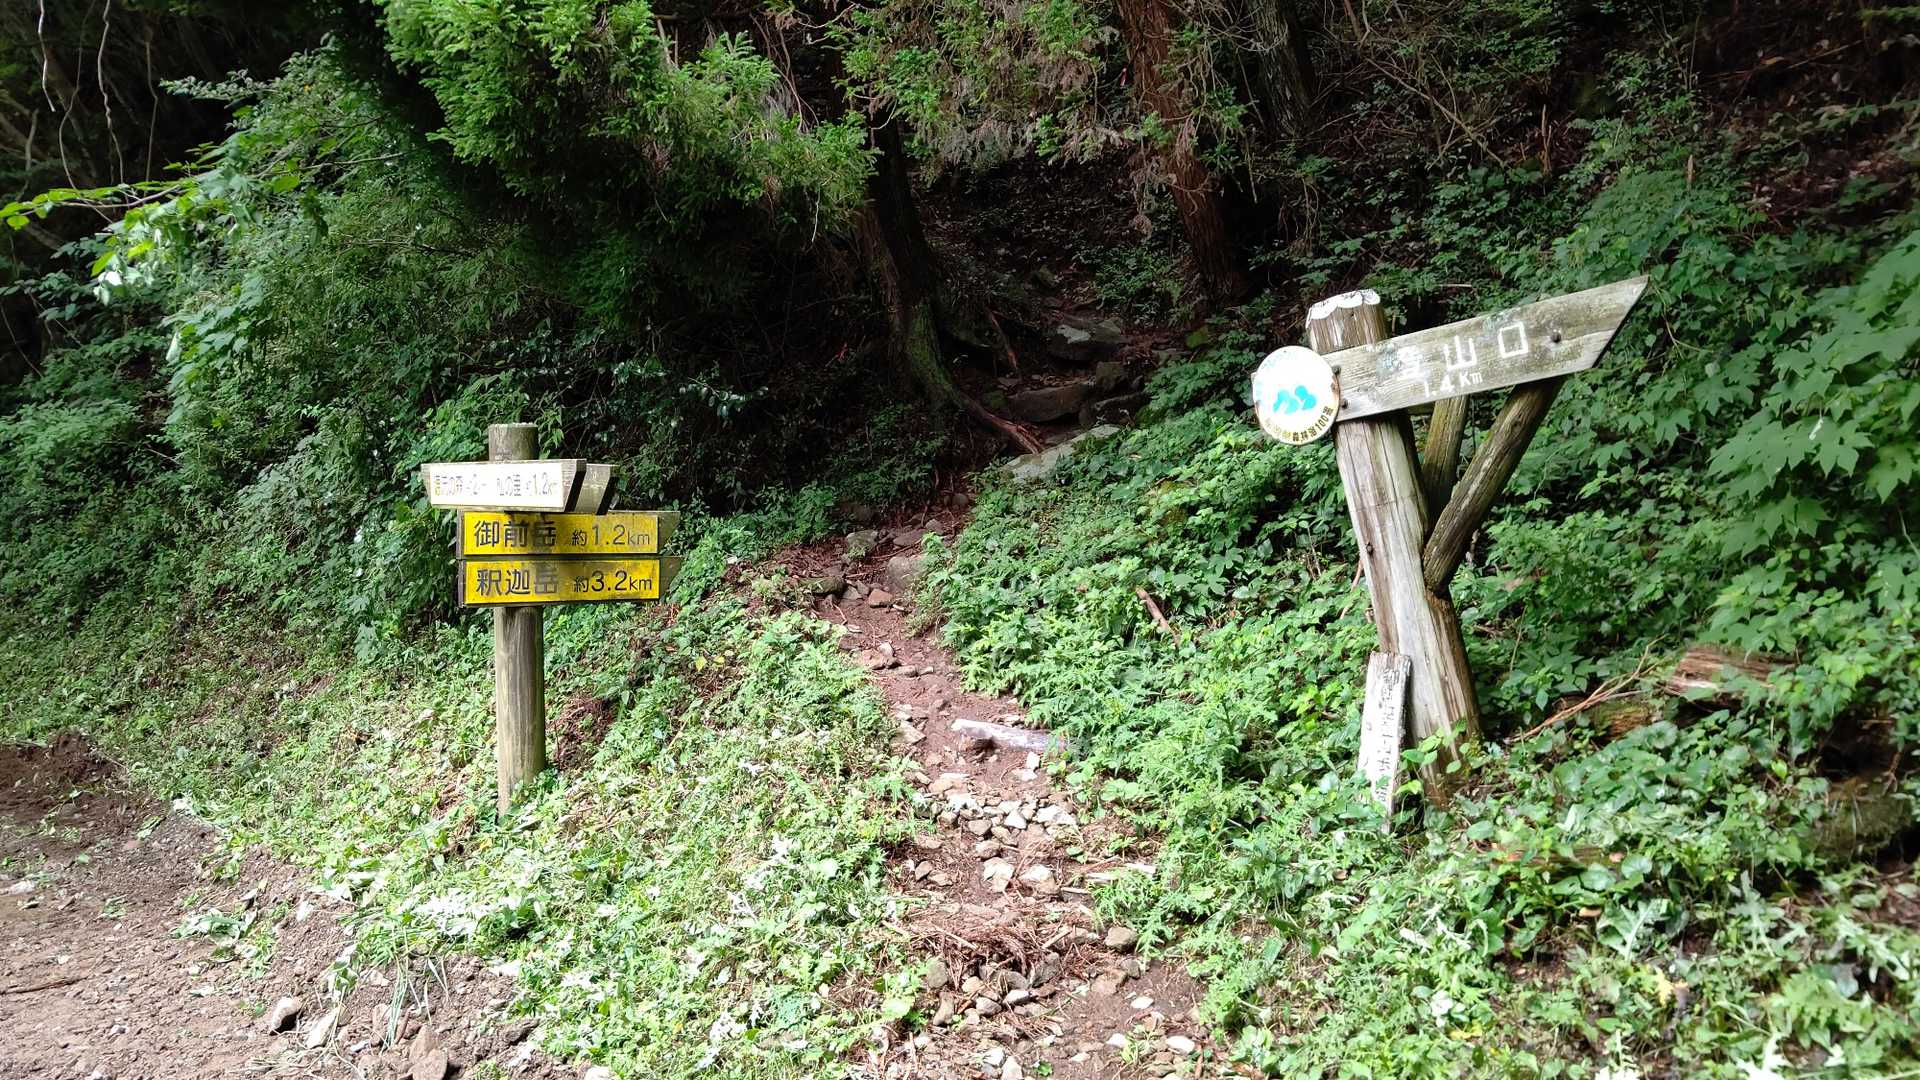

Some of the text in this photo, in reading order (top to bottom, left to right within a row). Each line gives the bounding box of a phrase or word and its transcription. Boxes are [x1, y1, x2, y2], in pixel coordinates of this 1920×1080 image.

[473, 519, 651, 548] 御前岳 約1.2km
[475, 567, 653, 597] 釈迦岳 約3.2km
